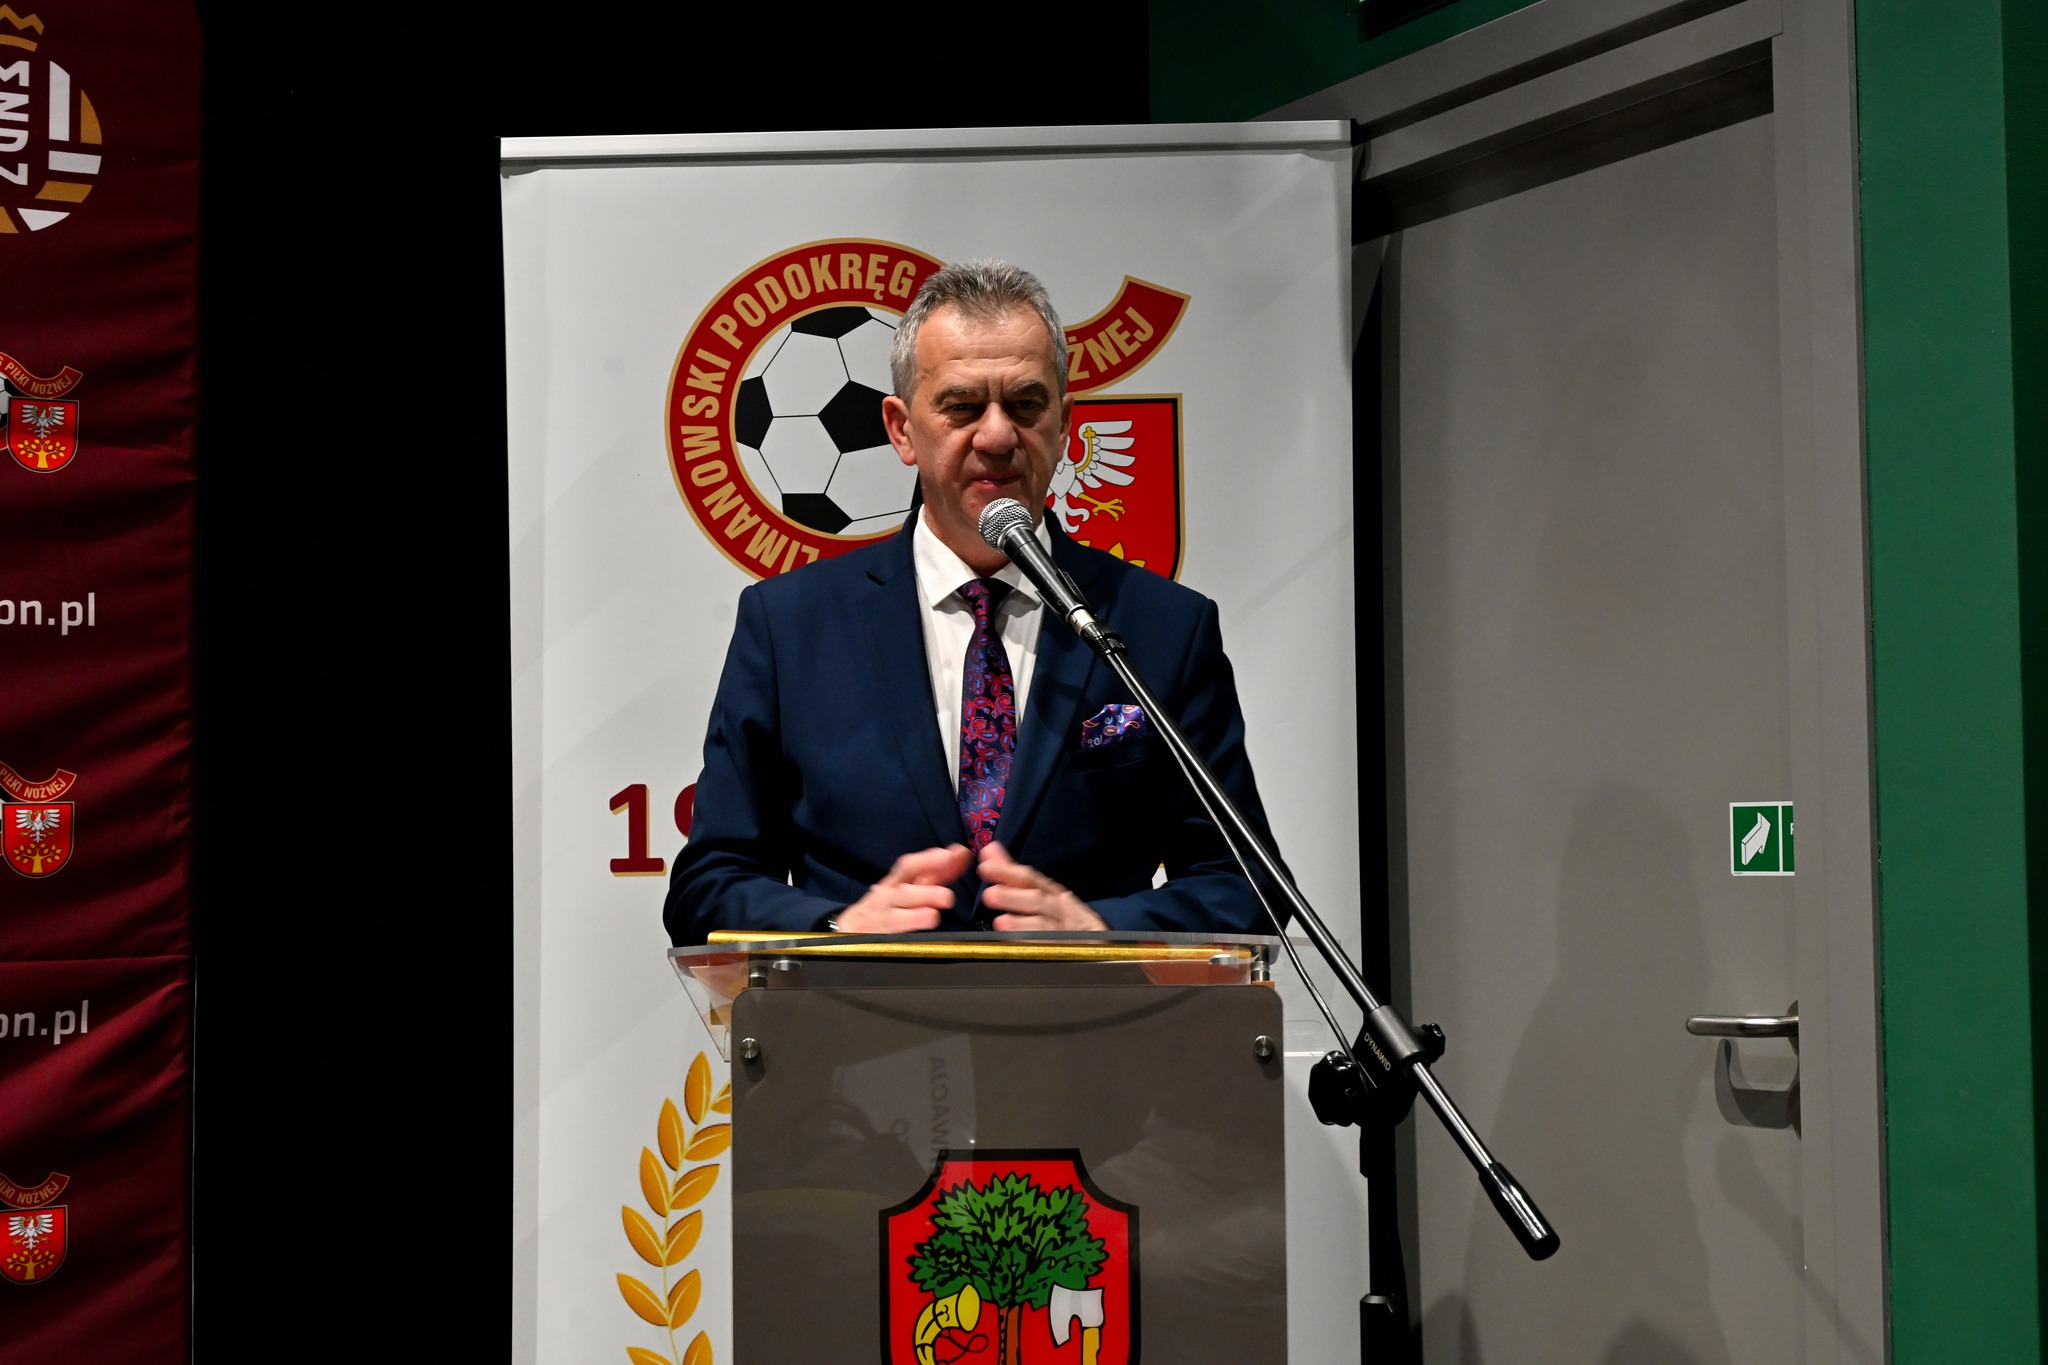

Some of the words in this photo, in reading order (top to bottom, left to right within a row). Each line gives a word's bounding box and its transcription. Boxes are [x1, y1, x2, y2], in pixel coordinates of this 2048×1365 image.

[710, 252, 917, 350] PODOKRĘG
[1066, 306, 1154, 381] ŻNEJ
[4, 361, 30, 387] PIŁKI
[30, 374, 73, 395] NOŻNEJ
[680, 347, 820, 574] LIMANOWSKI
[23, 777, 67, 799] NOŻNEJ
[16, 1181, 60, 1205] NOŻNEJ
